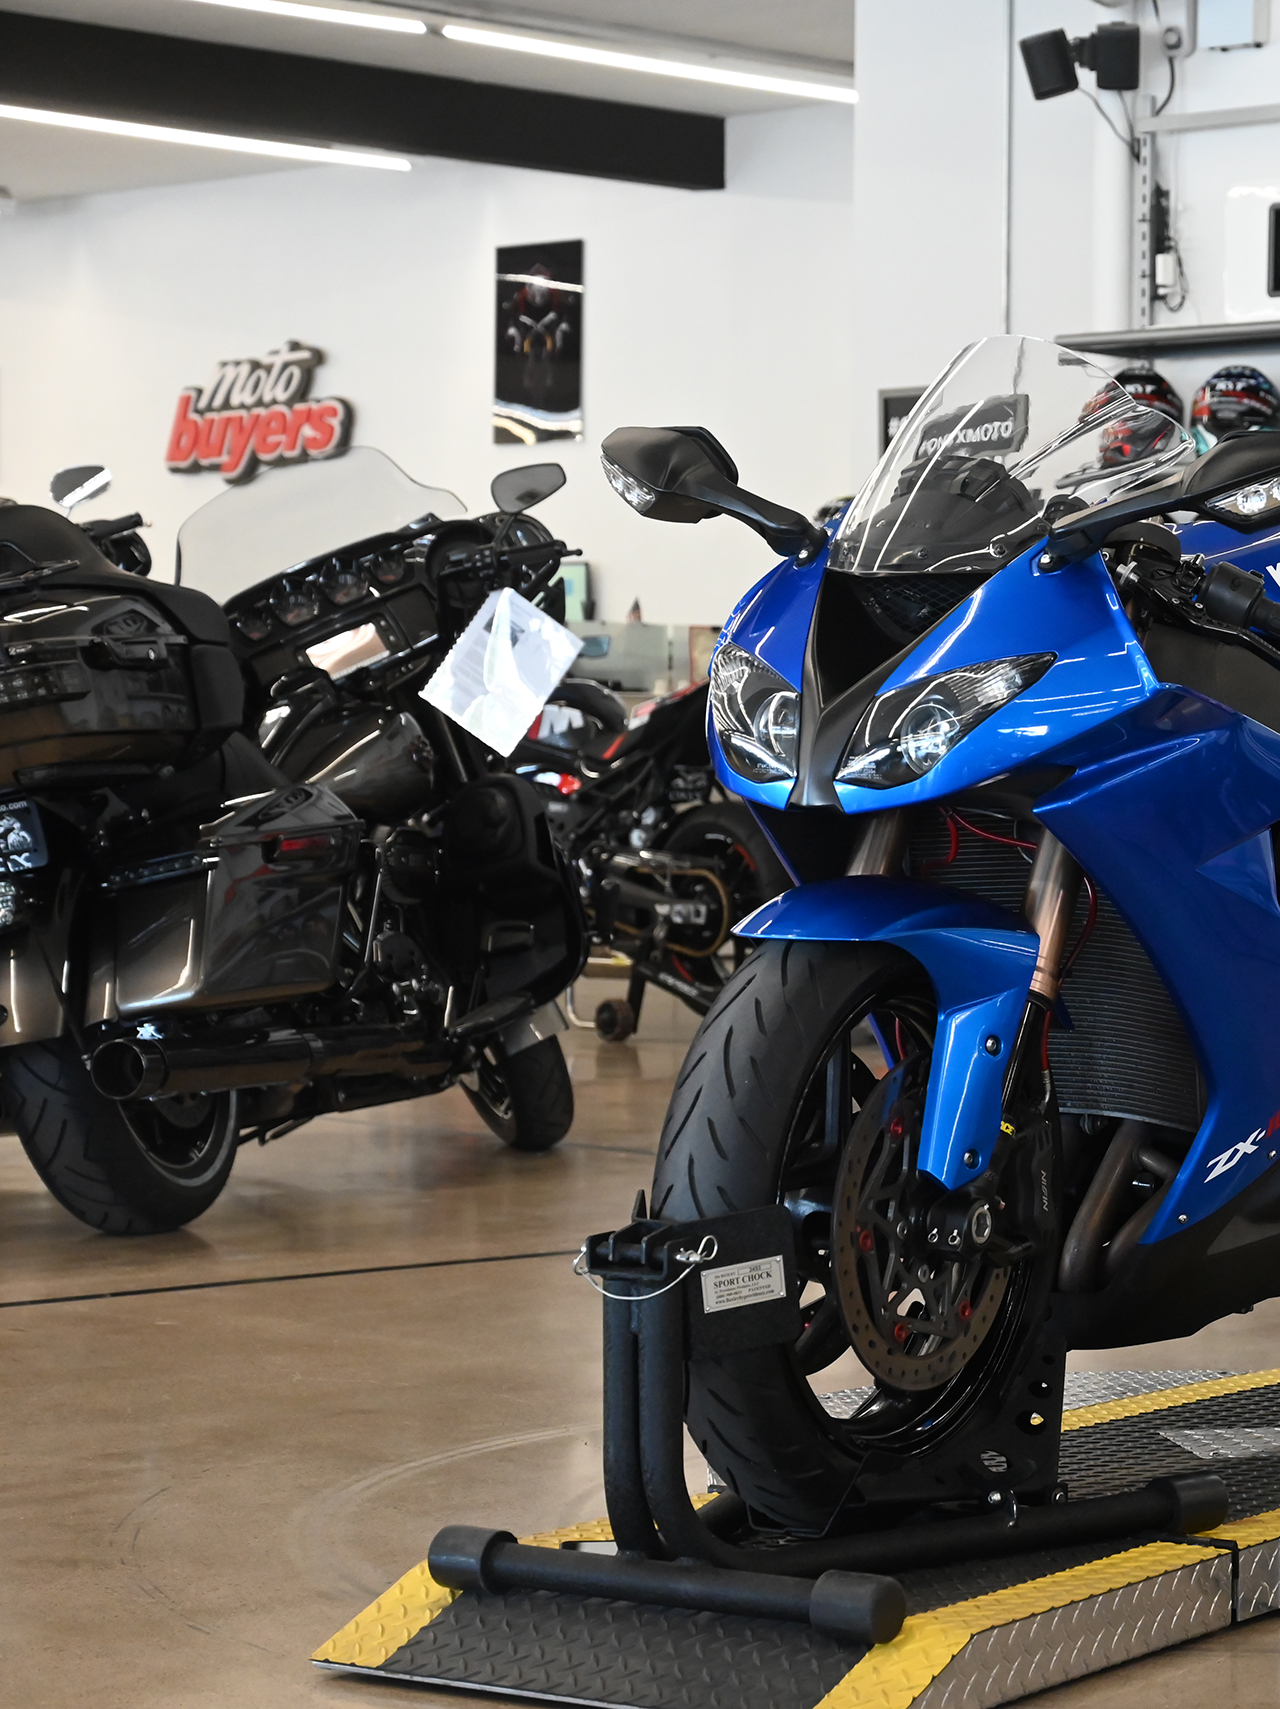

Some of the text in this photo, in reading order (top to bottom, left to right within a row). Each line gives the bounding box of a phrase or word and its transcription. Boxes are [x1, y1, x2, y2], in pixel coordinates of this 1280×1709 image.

[197, 341, 311, 409] Moto
[165, 388, 343, 479] buyers
[0, 800, 28, 813] o.com
[713, 1270, 773, 1290] SPORT CHOCK
